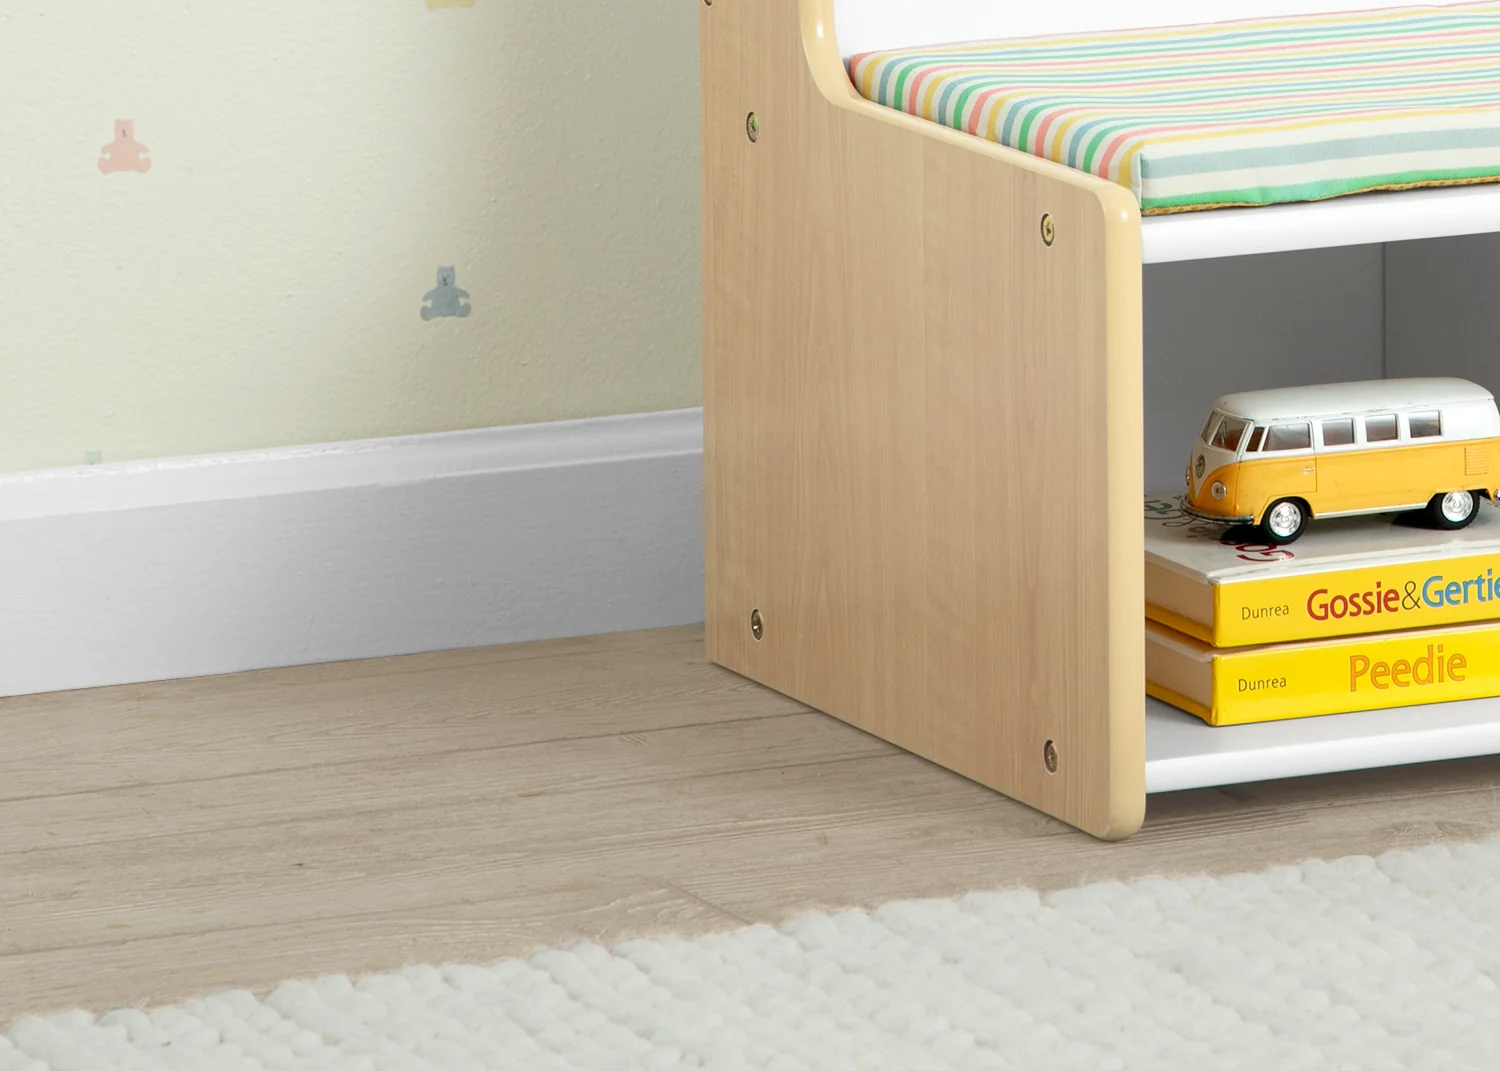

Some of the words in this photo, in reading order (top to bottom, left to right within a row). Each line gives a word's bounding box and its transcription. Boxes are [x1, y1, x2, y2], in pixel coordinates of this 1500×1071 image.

[1241, 602, 1290, 621] Dunrea
[1237, 675, 1287, 693] Dunrea
[1349, 644, 1467, 693] Peedie
